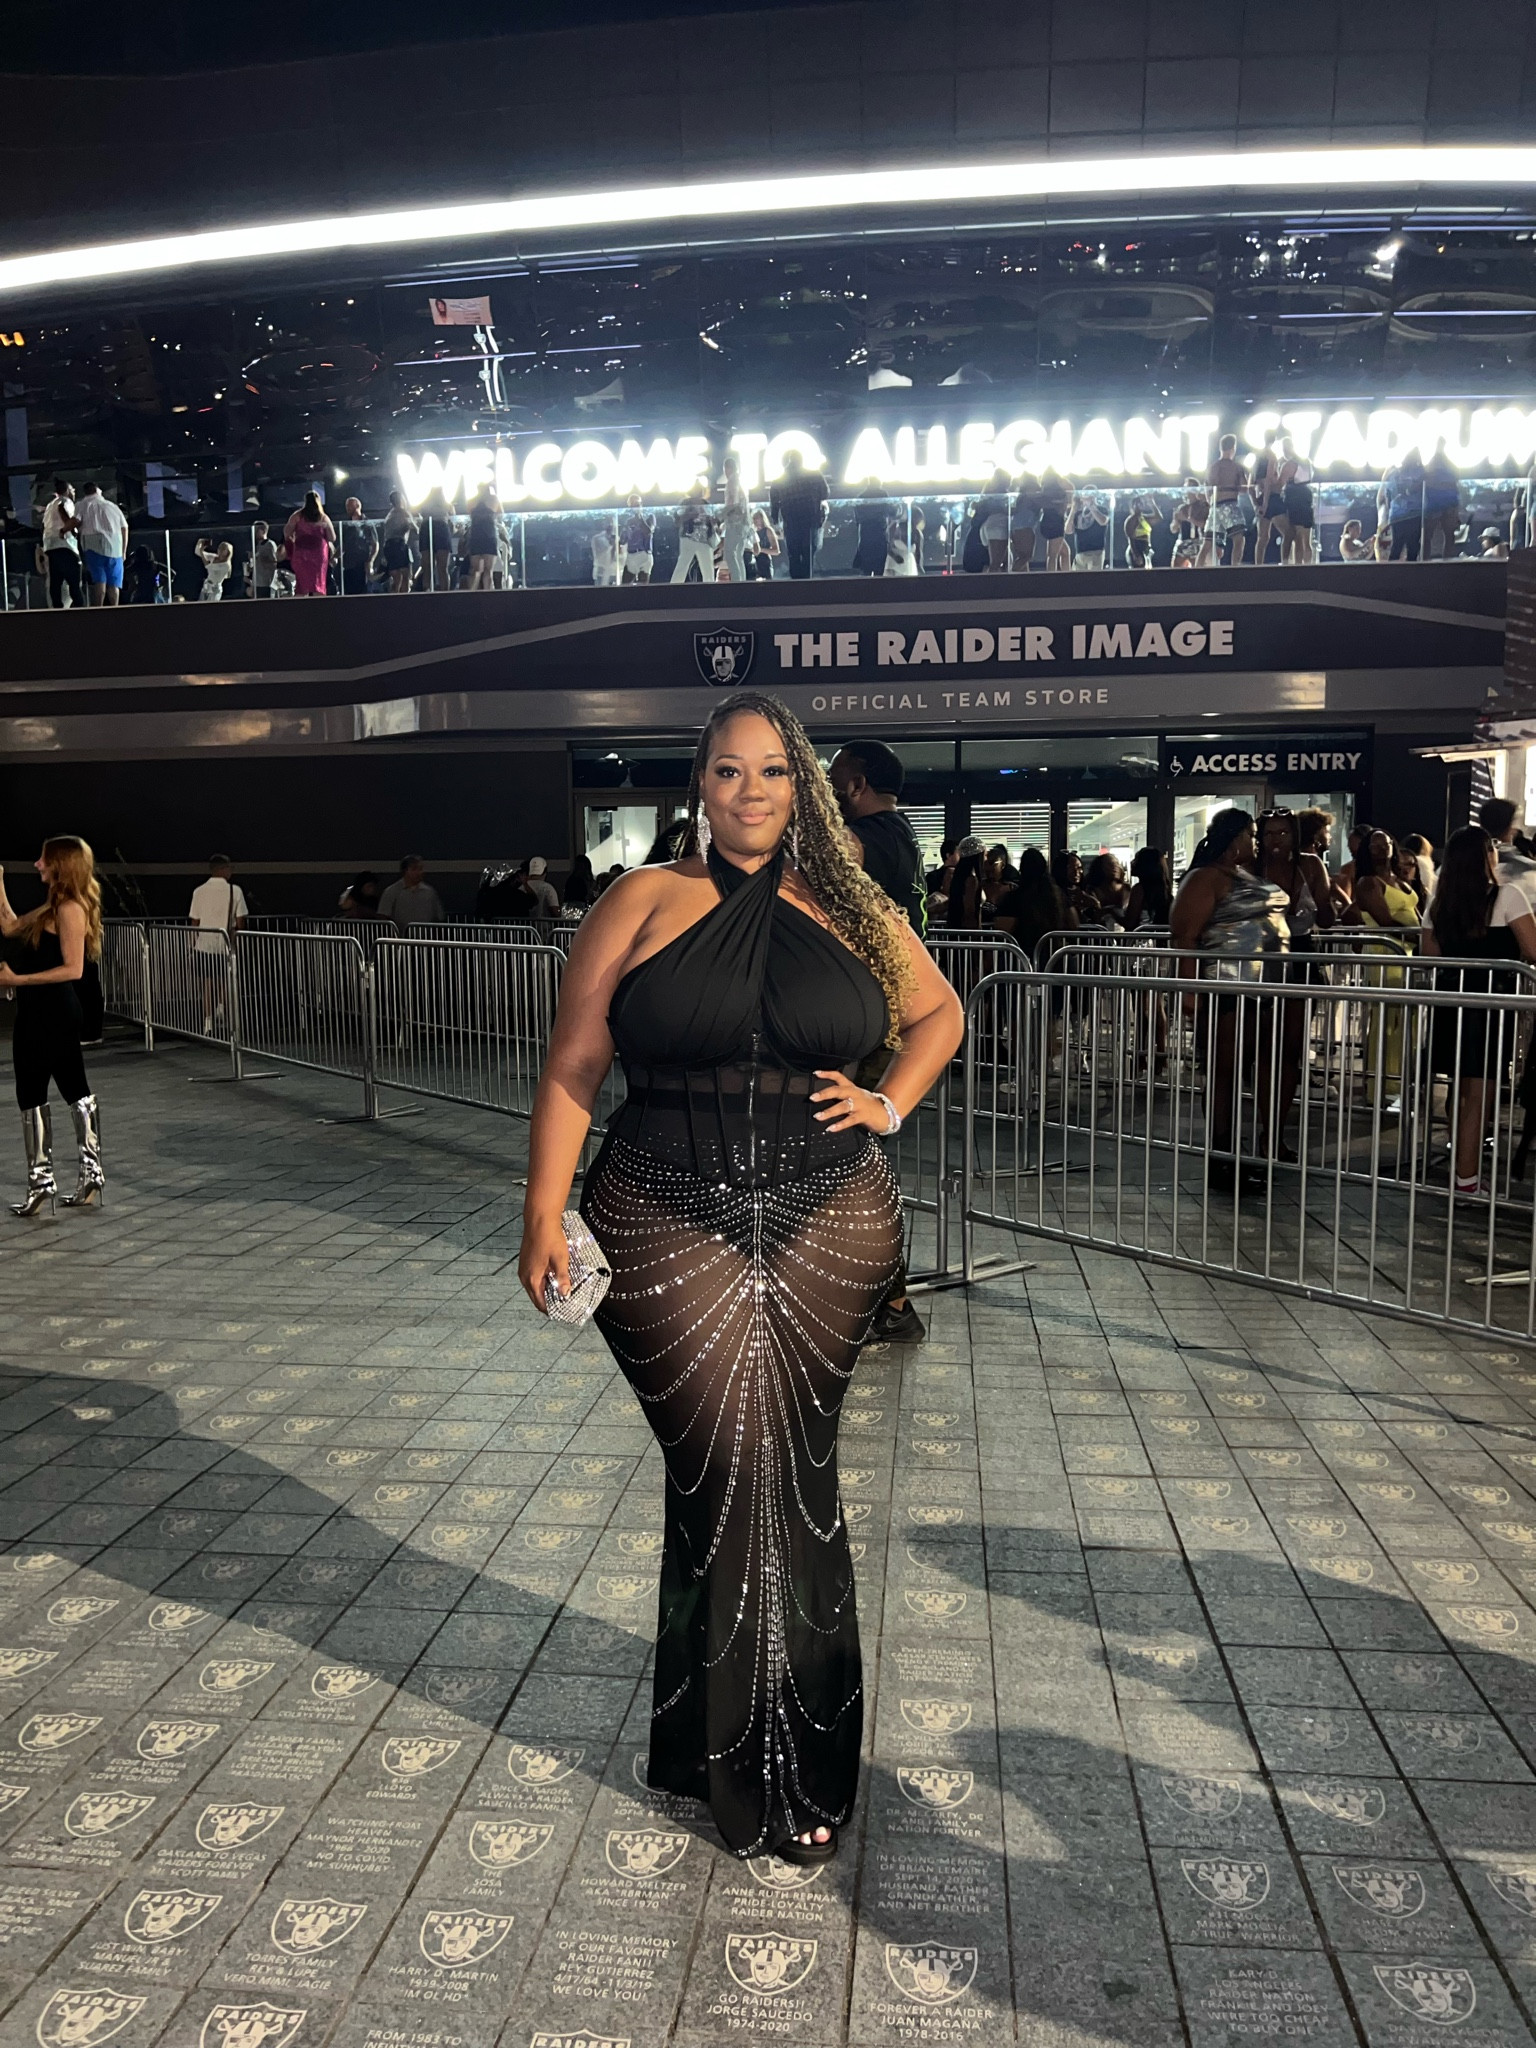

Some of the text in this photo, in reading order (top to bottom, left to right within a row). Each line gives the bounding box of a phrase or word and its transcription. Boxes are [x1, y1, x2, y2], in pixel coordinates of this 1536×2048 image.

[397, 436, 709, 505] WELCOME
[844, 415, 1219, 484] ALLEGIANT
[701, 635, 747, 645] RAIDERS
[774, 620, 1235, 668] THE RAIDER IMAGE
[811, 688, 1109, 711] OFFICIAL TEAM STORE
[1191, 752, 1362, 774] ACCESS ENTRY
[150, 1721, 216, 1733] RAIDERS
[390, 1740, 456, 1749] RAIDERS
[104, 1765, 180, 1776] BEST DAD EVER
[901, 1770, 970, 1780] RAIDERS
[119, 1773, 142, 1782] YOU
[366, 1790, 418, 1800] EDWARDS
[491, 1785, 520, 1793] ONCE
[533, 1787, 571, 1796] RAIDER
[81, 1795, 149, 1806] RAIDERS
[478, 1799, 527, 1809] SAUCILLO
[479, 1791, 574, 1804] ALWAYS RAIDER
[207, 1807, 279, 1817] RAIDERS
[613, 1808, 655, 1818] SOFIA &
[674, 1803, 698, 1811] IZZY
[327, 1817, 422, 1830] WATCHING FROM
[901, 1816, 968, 1828] AND FAMILY
[346, 1827, 392, 1837] HEAVEN
[476, 1823, 549, 1836] RAIDERS
[887, 1824, 982, 1837] NATION FOREVER
[305, 1833, 423, 1848] MAYNOR HERNANDEZ
[611, 1833, 685, 1845] RAIDERS
[157, 1849, 267, 1862] OAKLAND TO VEGAS
[363, 1845, 391, 1854] 2020
[11, 1851, 113, 1867] DAD & RAIDER FAN
[157, 1858, 255, 1870] RAIDERS FOREVER
[316, 1852, 391, 1864] NO TO COVID
[876, 1854, 991, 1867] IN LOVING MEMORY
[170, 1868, 205, 1878] SCOTT
[206, 1869, 251, 1879] FAMILY
[482, 1869, 503, 1877] THE
[880, 1863, 934, 1873] OF BRIAN
[1185, 1862, 1264, 1873] RAIDERS
[1338, 1869, 1418, 1881] RAIDERS
[472, 1878, 502, 1887] SOSA
[580, 1878, 687, 1891] HOWARD MELTZER
[42, 1888, 80, 1899] SILVER
[462, 1887, 505, 1897] FAMILY
[584, 1887, 610, 1896] AKA
[722, 1887, 839, 1903] ANNE RUTH REPNAK
[139, 1894, 215, 1907] RAIDERS
[597, 1897, 660, 1909] SINCE 1970
[734, 1898, 824, 1911] PRIDE-LOYALTY
[877, 1901, 990, 1913] AND BROTHER
[283, 1903, 361, 1917] RAIDERS
[731, 1908, 824, 1921] RAIDER NATION
[429, 1915, 509, 1928] RAIDERS
[556, 1930, 679, 1948] IN LOVING MEMORY
[1241, 1932, 1301, 1943] WARRIOR
[89, 1941, 120, 1950] JUST
[559, 1941, 669, 1959] OF OUR FAVORITE
[730, 1938, 813, 1953] RAIDERS
[93, 1952, 142, 1964] MANUEL
[160, 1957, 170, 1966] &
[567, 1952, 613, 1965] RAIDER
[890, 1947, 973, 1961] RAIDERS
[245, 1953, 338, 1969] TORRES FAMILY
[78, 1961, 172, 1977] SUAREZ FAMILY
[249, 1964, 319, 1978] REY & LUPE
[388, 1966, 431, 1977] HARRY
[450, 1970, 499, 1983] MARTIN
[559, 1962, 655, 1980] REY GUTIERREZ
[1228, 1968, 1264, 1978] KARY
[1379, 1969, 1466, 1981] RAIDERS
[409, 1978, 470, 1992] 1939-2008
[553, 1973, 599, 1985] 4/17/64
[1215, 1980, 1239, 1988] LOS
[423, 1991, 440, 2000] OL
[552, 1985, 571, 1995] WE
[576, 1987, 609, 1999] LOVE
[719, 1993, 738, 2004] GO
[1209, 1988, 1315, 2002] RAIDER NATION
[56, 1993, 140, 2010] RAIDERS
[1200, 2000, 1329, 2013] FRANKIE AND JOEY
[214, 2009, 300, 2024] RAIDERS
[706, 2005, 813, 2021] JORGE SAUCEDO
[870, 2002, 993, 2019] FOREVER A RAIDER
[881, 2015, 981, 2031] JUAN MAGANA
[1207, 2011, 1329, 2025] WERE TOO CHEAP
[727, 2018, 790, 2032] 1974-2020
[1229, 2023, 1315, 2036] TO BUY ONE
[366, 2029, 462, 2046] FROM 1983 TO
[899, 2028, 964, 2041] 1978-2016
[536, 2037, 627, 2048] RAIDERS
